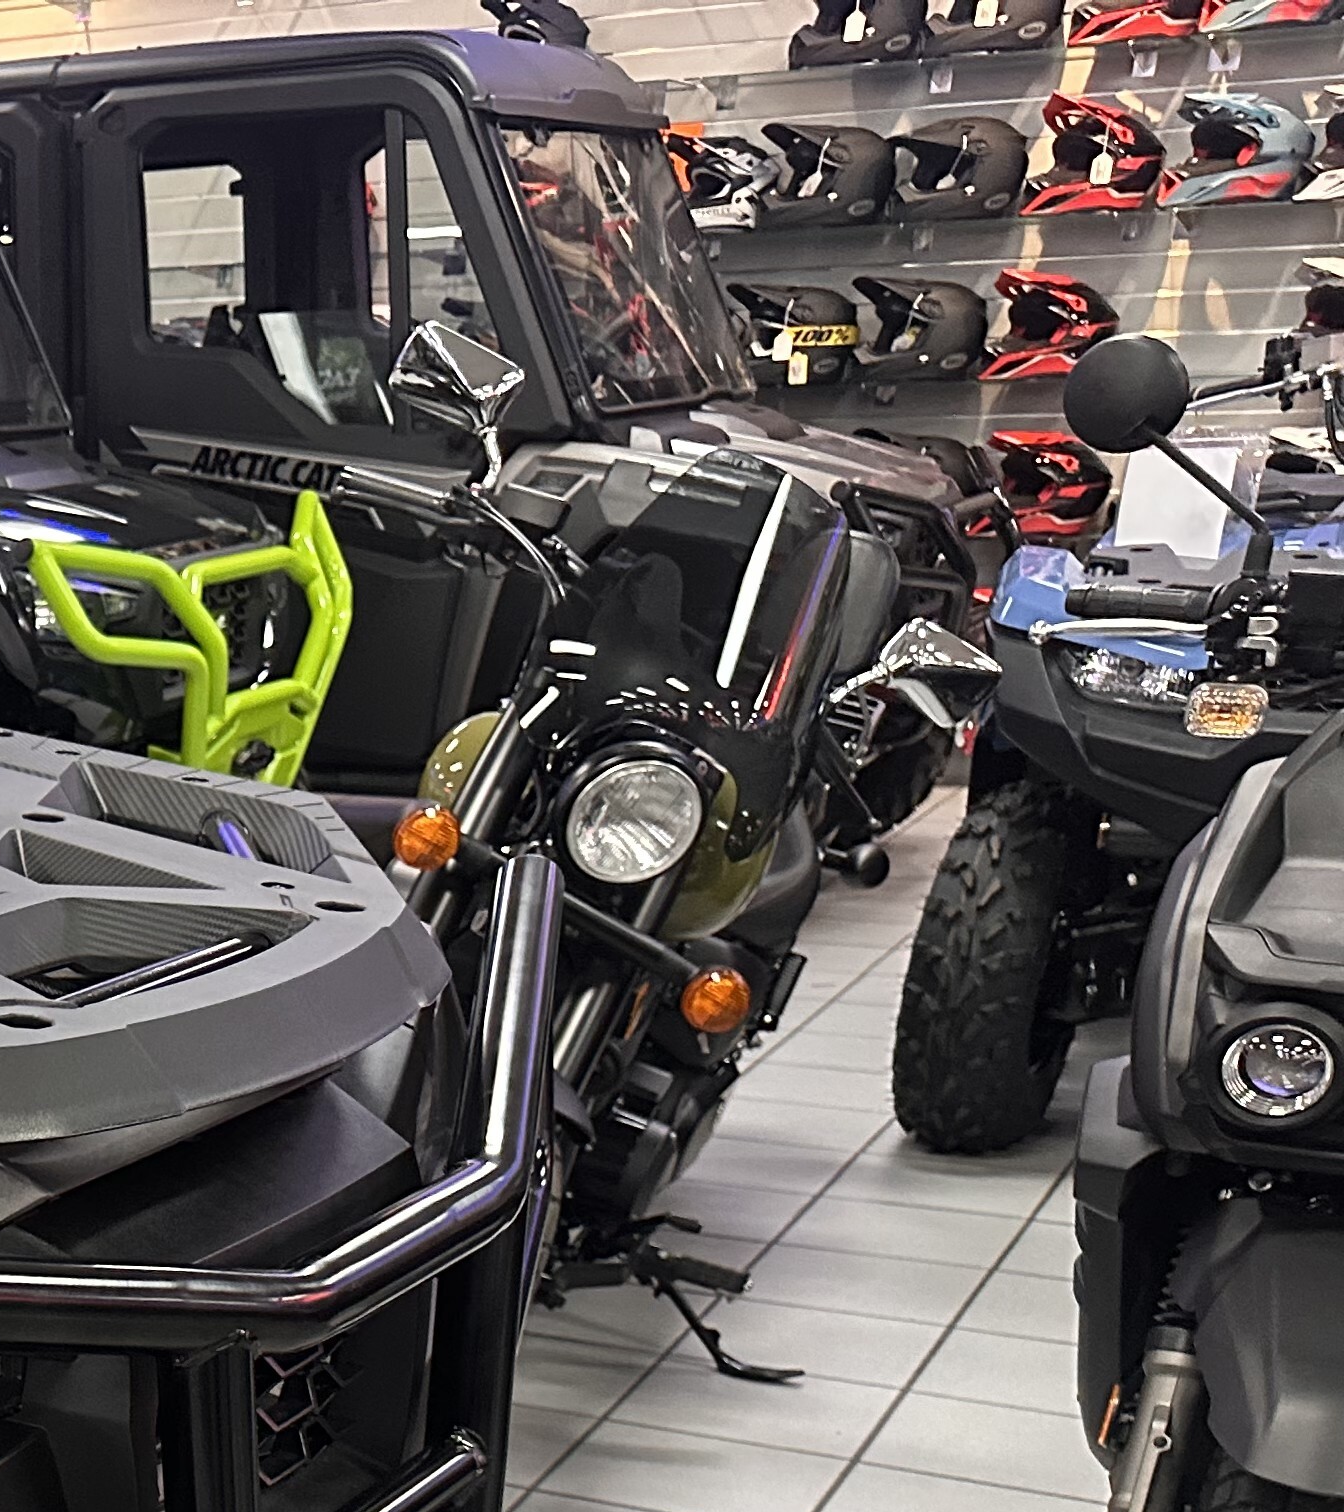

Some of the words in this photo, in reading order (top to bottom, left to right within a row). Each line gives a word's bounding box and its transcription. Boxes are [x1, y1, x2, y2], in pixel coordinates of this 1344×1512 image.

[793, 326, 850, 344] 100%
[191, 445, 290, 487] ARCTIC
[291, 459, 345, 492] CAT
